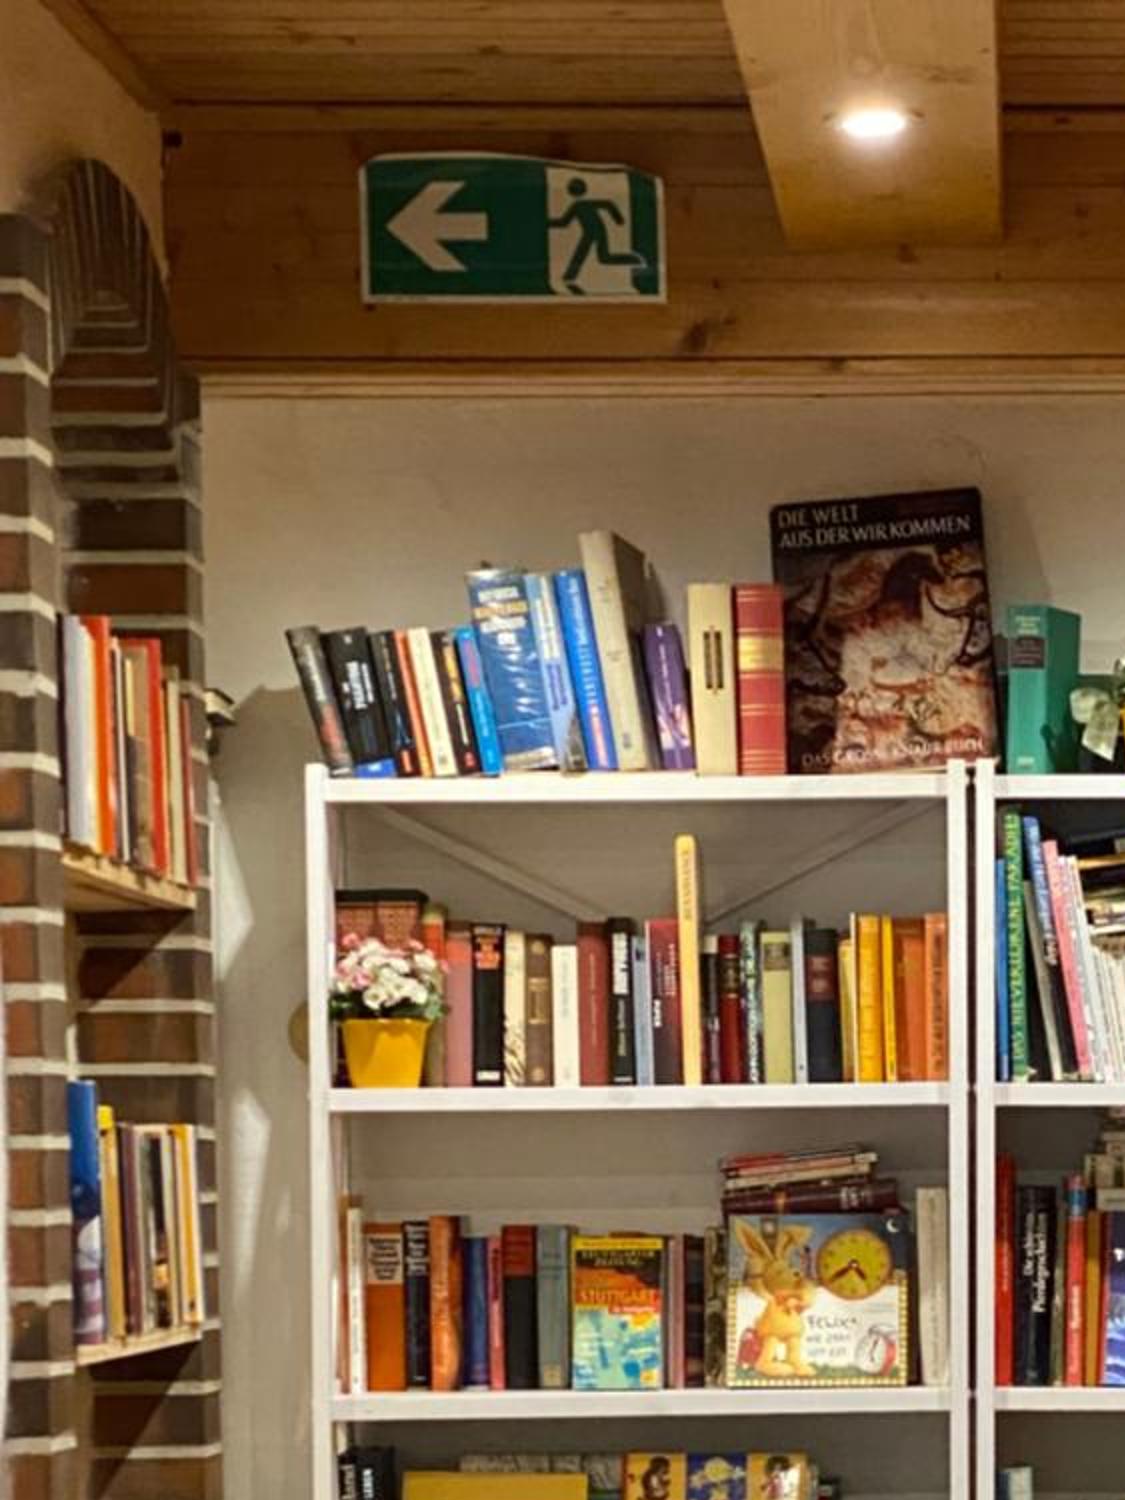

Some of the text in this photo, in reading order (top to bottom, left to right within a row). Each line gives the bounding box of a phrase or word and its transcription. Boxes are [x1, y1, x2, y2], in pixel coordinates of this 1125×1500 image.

[778, 503, 859, 529] DIE WELT
[781, 515, 972, 549] AUS DER WIR KOMMEN
